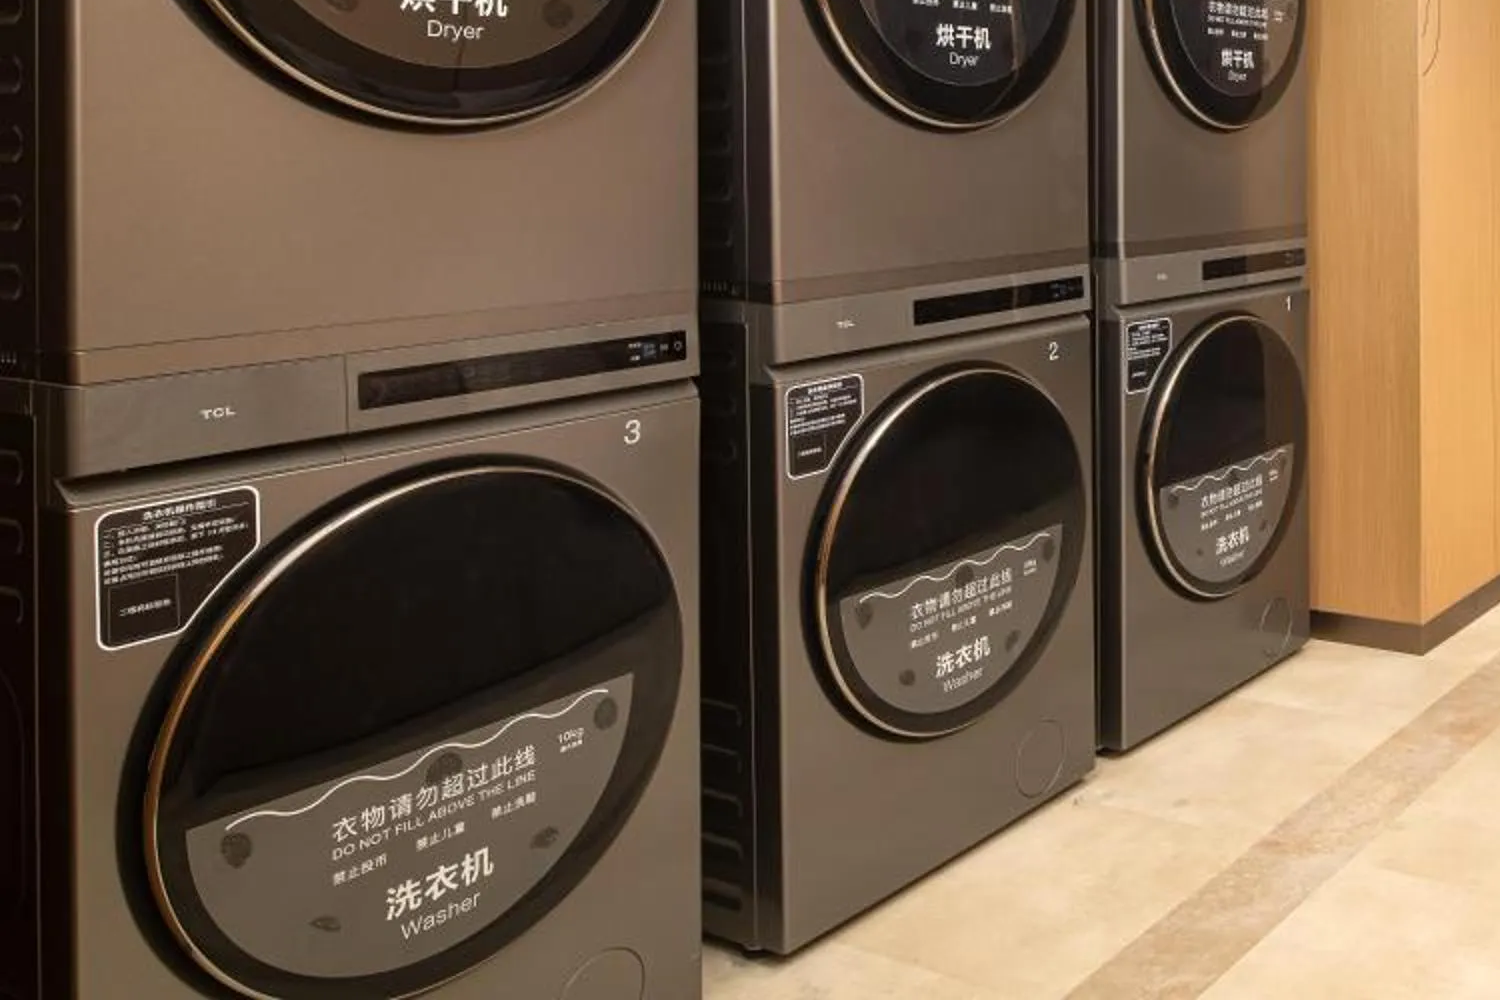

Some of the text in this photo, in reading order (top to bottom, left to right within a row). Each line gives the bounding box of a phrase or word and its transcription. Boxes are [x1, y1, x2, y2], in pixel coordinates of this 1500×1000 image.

[427, 19, 485, 43] Dryer
[935, 23, 992, 50] 烘干机
[949, 51, 979, 67] Dryer
[1049, 341, 1060, 361] 2
[200, 406, 237, 421] TCL
[622, 418, 642, 447] 3
[936, 635, 991, 678] 洗衣机
[332, 744, 536, 843] 衣物请勿超过此线
[332, 769, 536, 861] DO NOT FILL ABOVE THE LINE
[386, 845, 495, 921] 洗衣机
[400, 891, 481, 941] Washer
